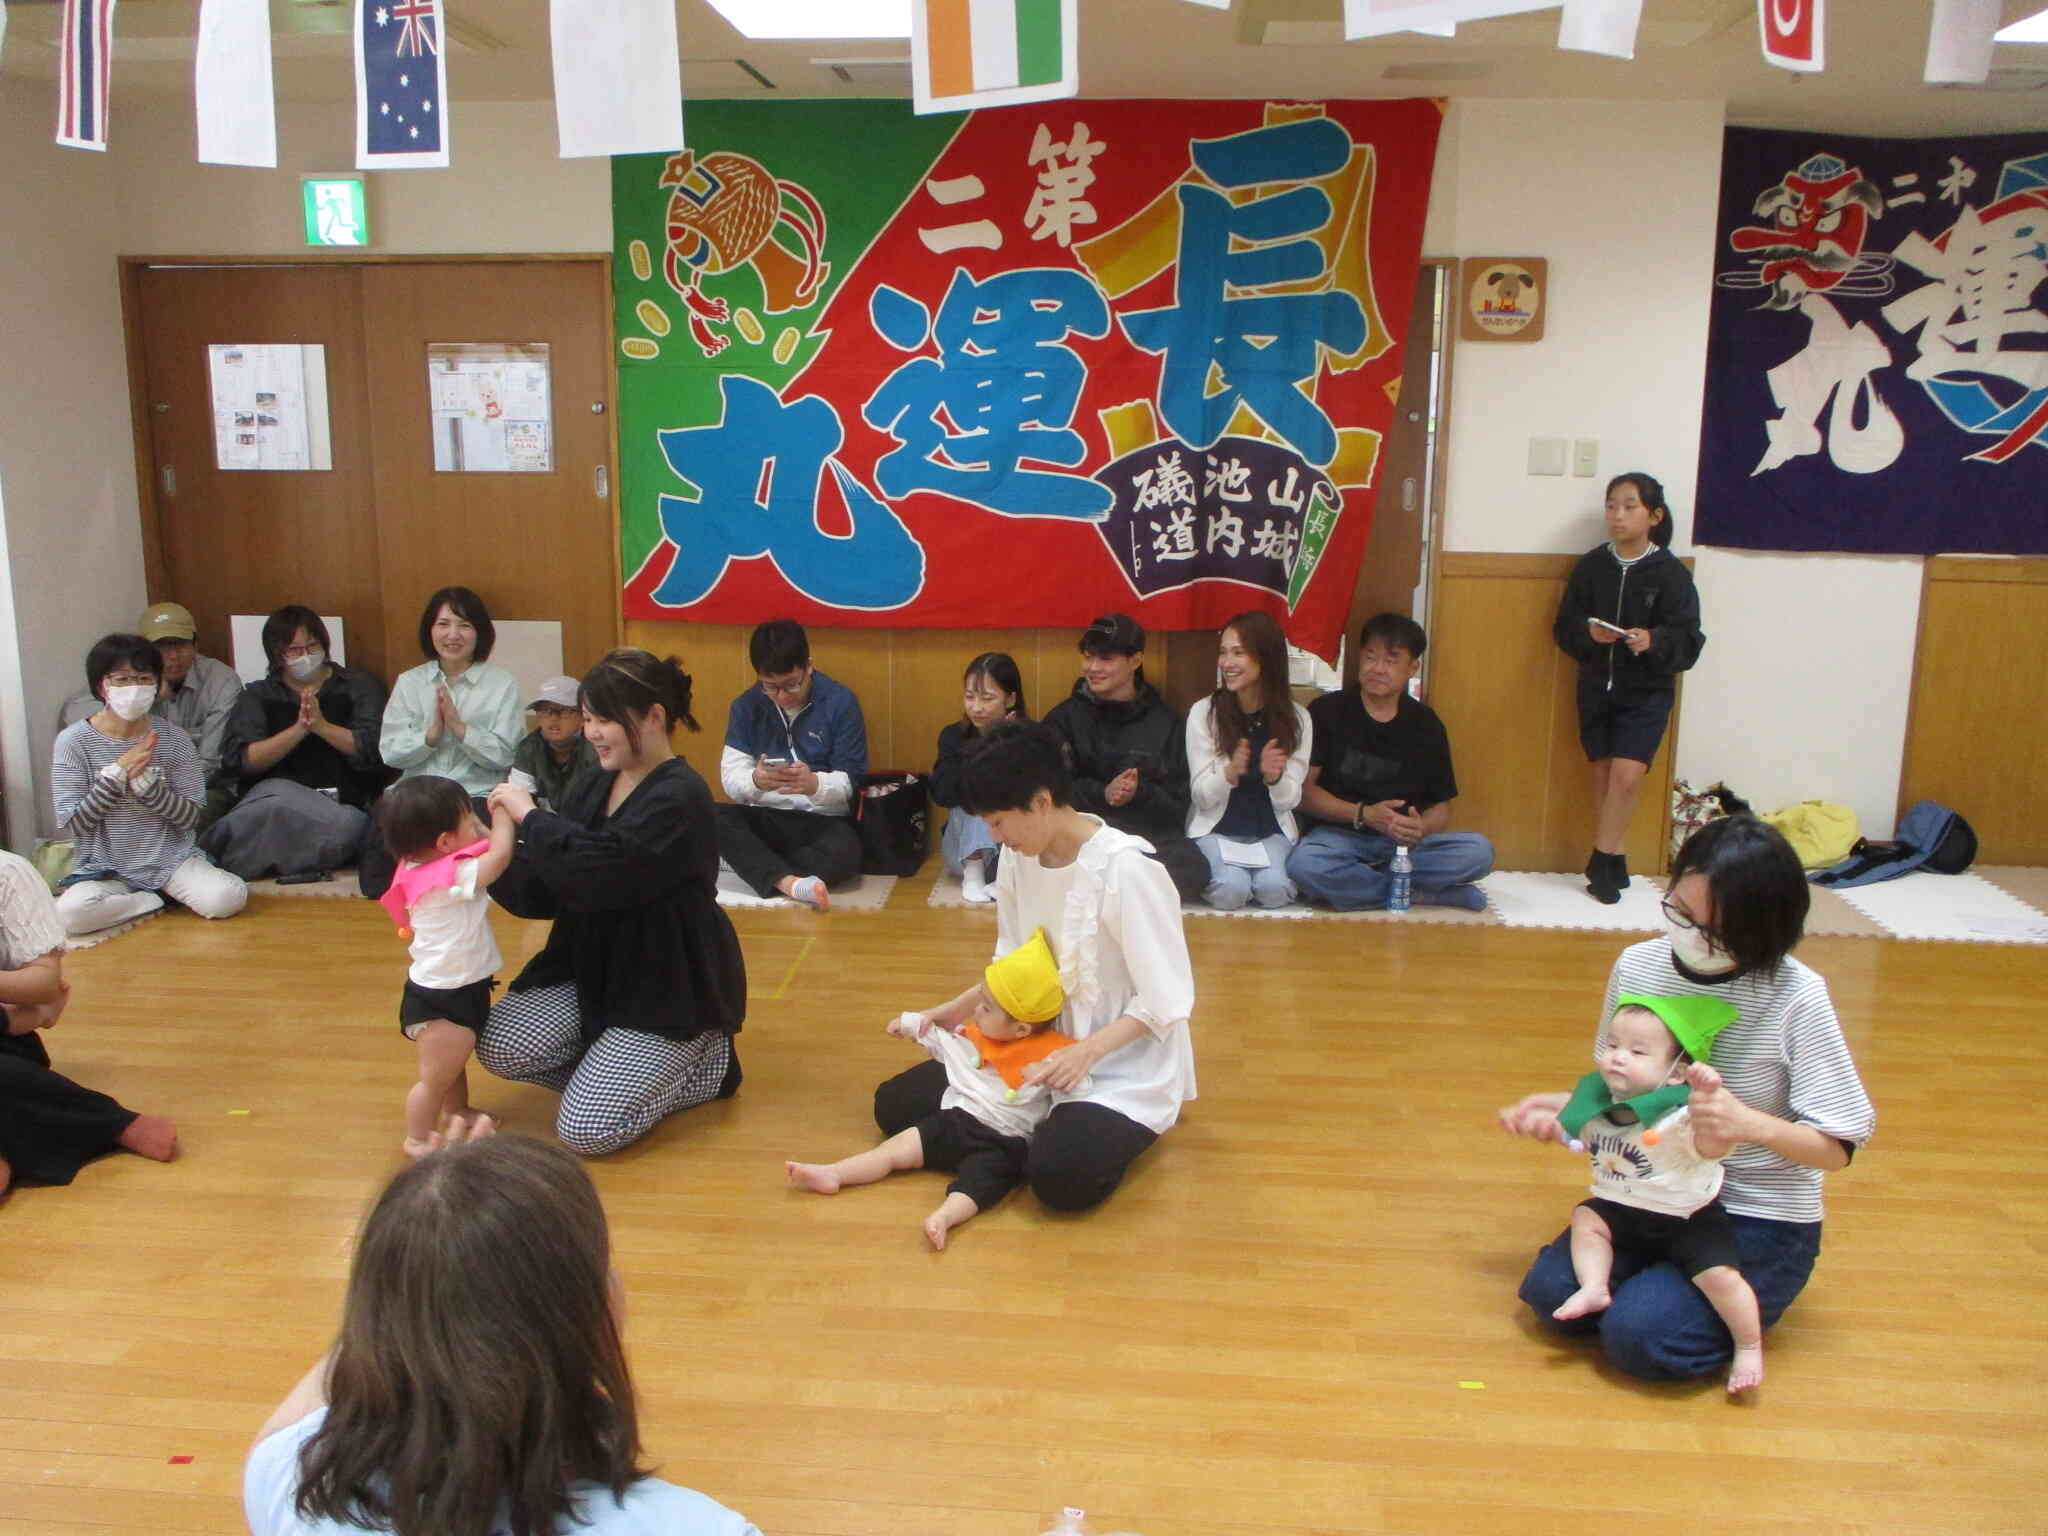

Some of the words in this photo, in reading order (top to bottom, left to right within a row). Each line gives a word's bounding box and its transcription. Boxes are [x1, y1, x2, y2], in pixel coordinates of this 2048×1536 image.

[917, 121, 1108, 254] 第二
[1202, 454, 1253, 559] 池内
[1251, 466, 1304, 580] 山城
